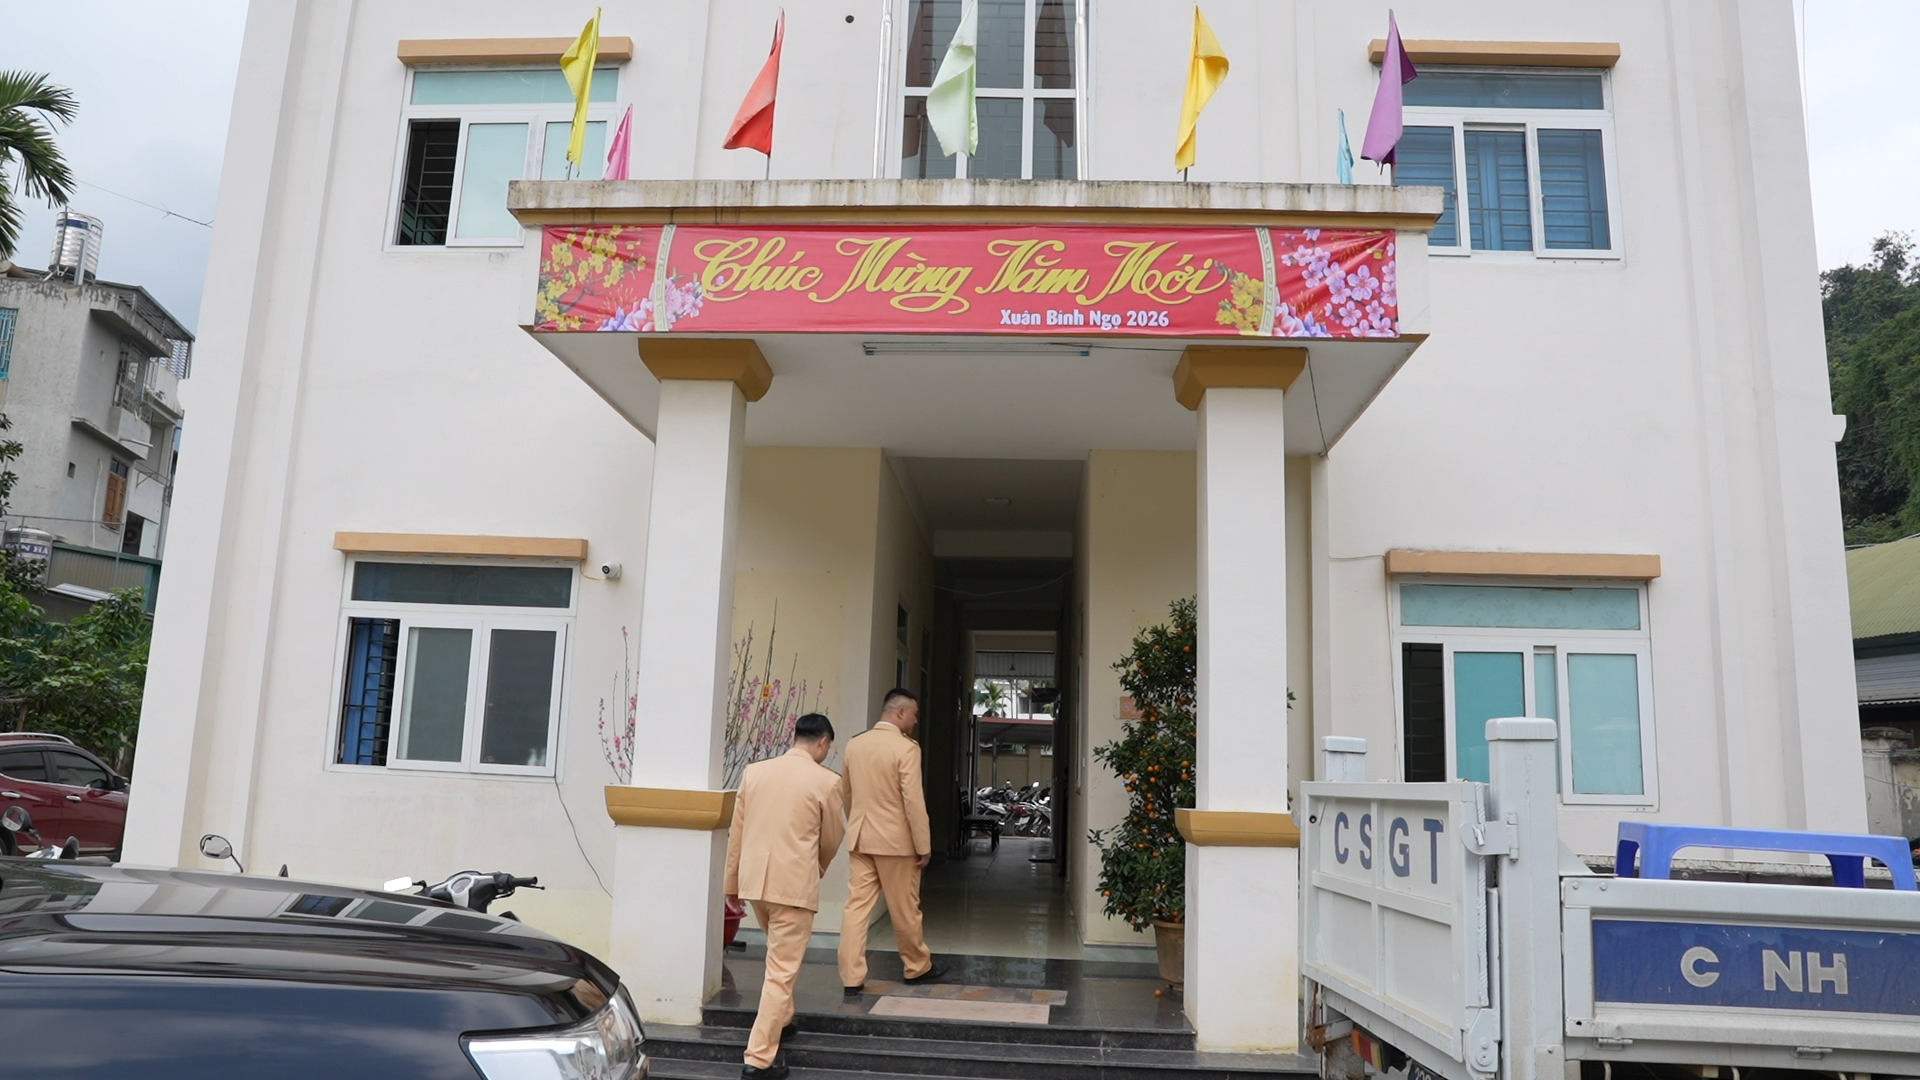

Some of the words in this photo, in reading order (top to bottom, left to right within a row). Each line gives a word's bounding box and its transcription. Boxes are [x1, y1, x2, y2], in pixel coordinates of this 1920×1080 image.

[693, 236, 824, 302] Chúc
[808, 236, 974, 314] Mừng
[974, 239, 1091, 294] Năm
[1075, 241, 1228, 306] Mới
[1000, 309, 1042, 325] Xuân
[1046, 309, 1084, 325] Bính
[1089, 310, 1122, 330] Ngọ
[1126, 310, 1170, 327] 2026
